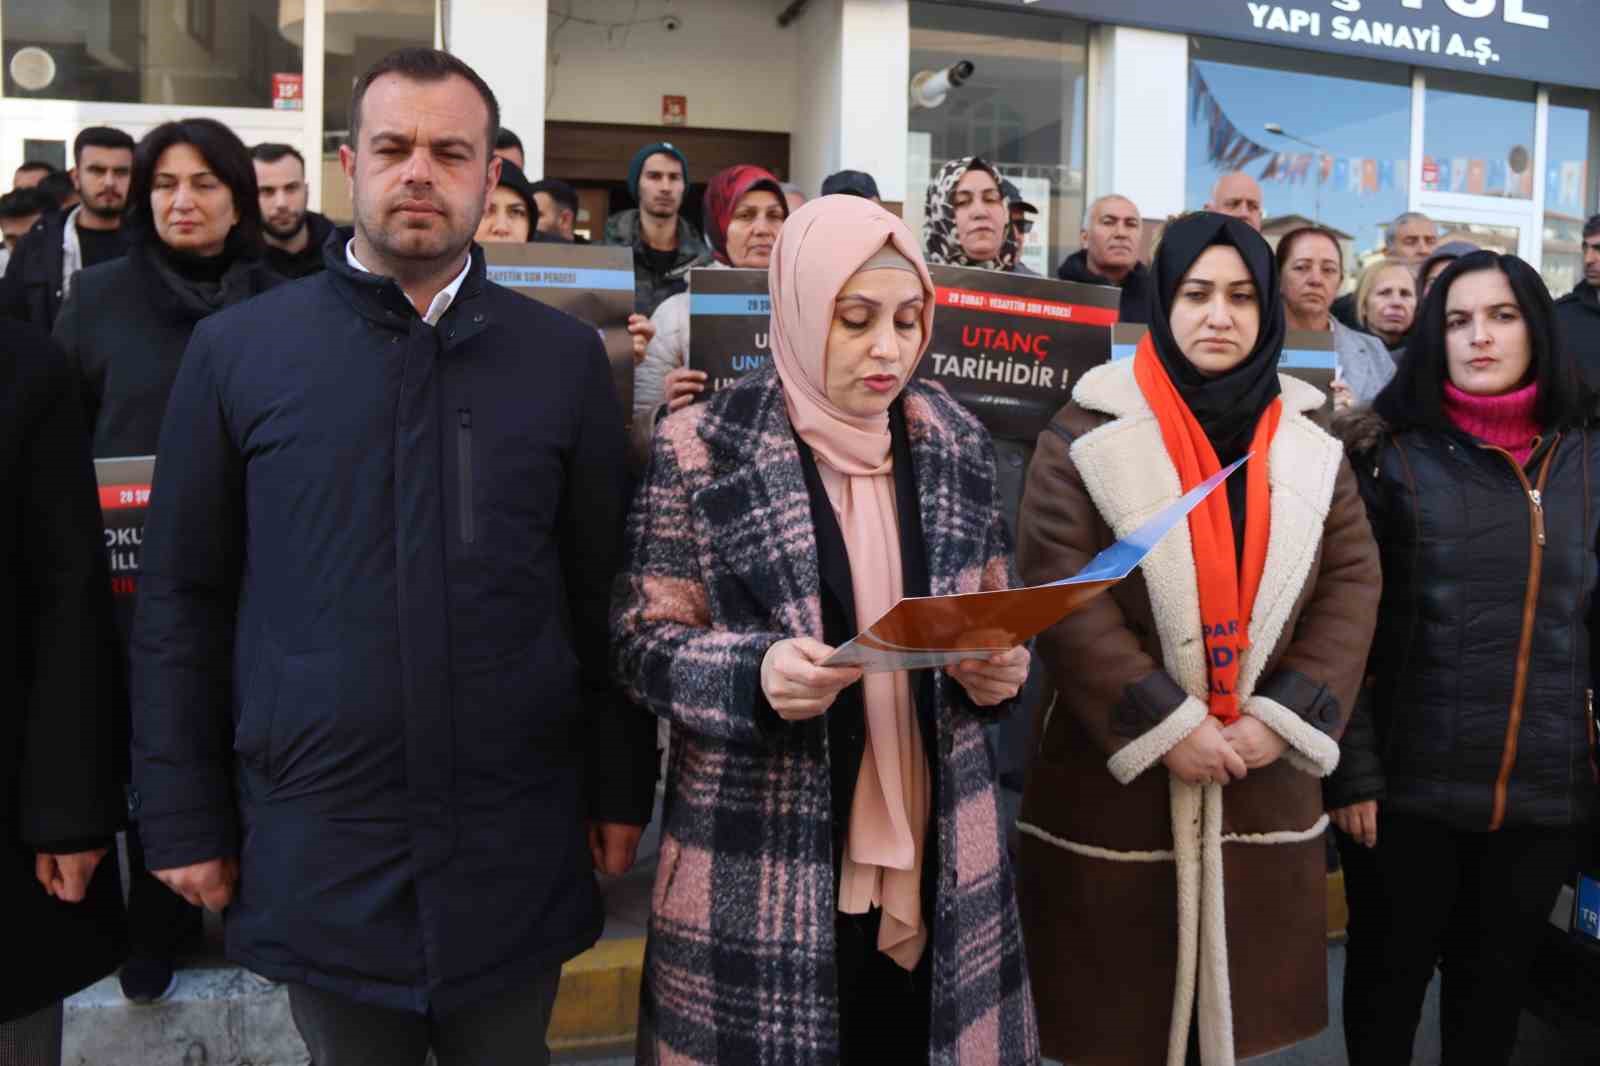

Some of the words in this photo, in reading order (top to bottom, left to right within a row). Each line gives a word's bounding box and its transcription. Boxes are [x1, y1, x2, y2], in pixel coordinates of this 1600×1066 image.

[1248, 2, 1320, 36] YAPI
[1331, 16, 1440, 54] SANAYİ
[1446, 32, 1500, 66] A.Ş.
[960, 293, 984, 307] ŞUBAT
[1026, 301, 1042, 314] SON
[961, 325, 1051, 361] UTANÇ
[931, 352, 1055, 388] TARİHİDİR
[1060, 368, 1070, 390] !
